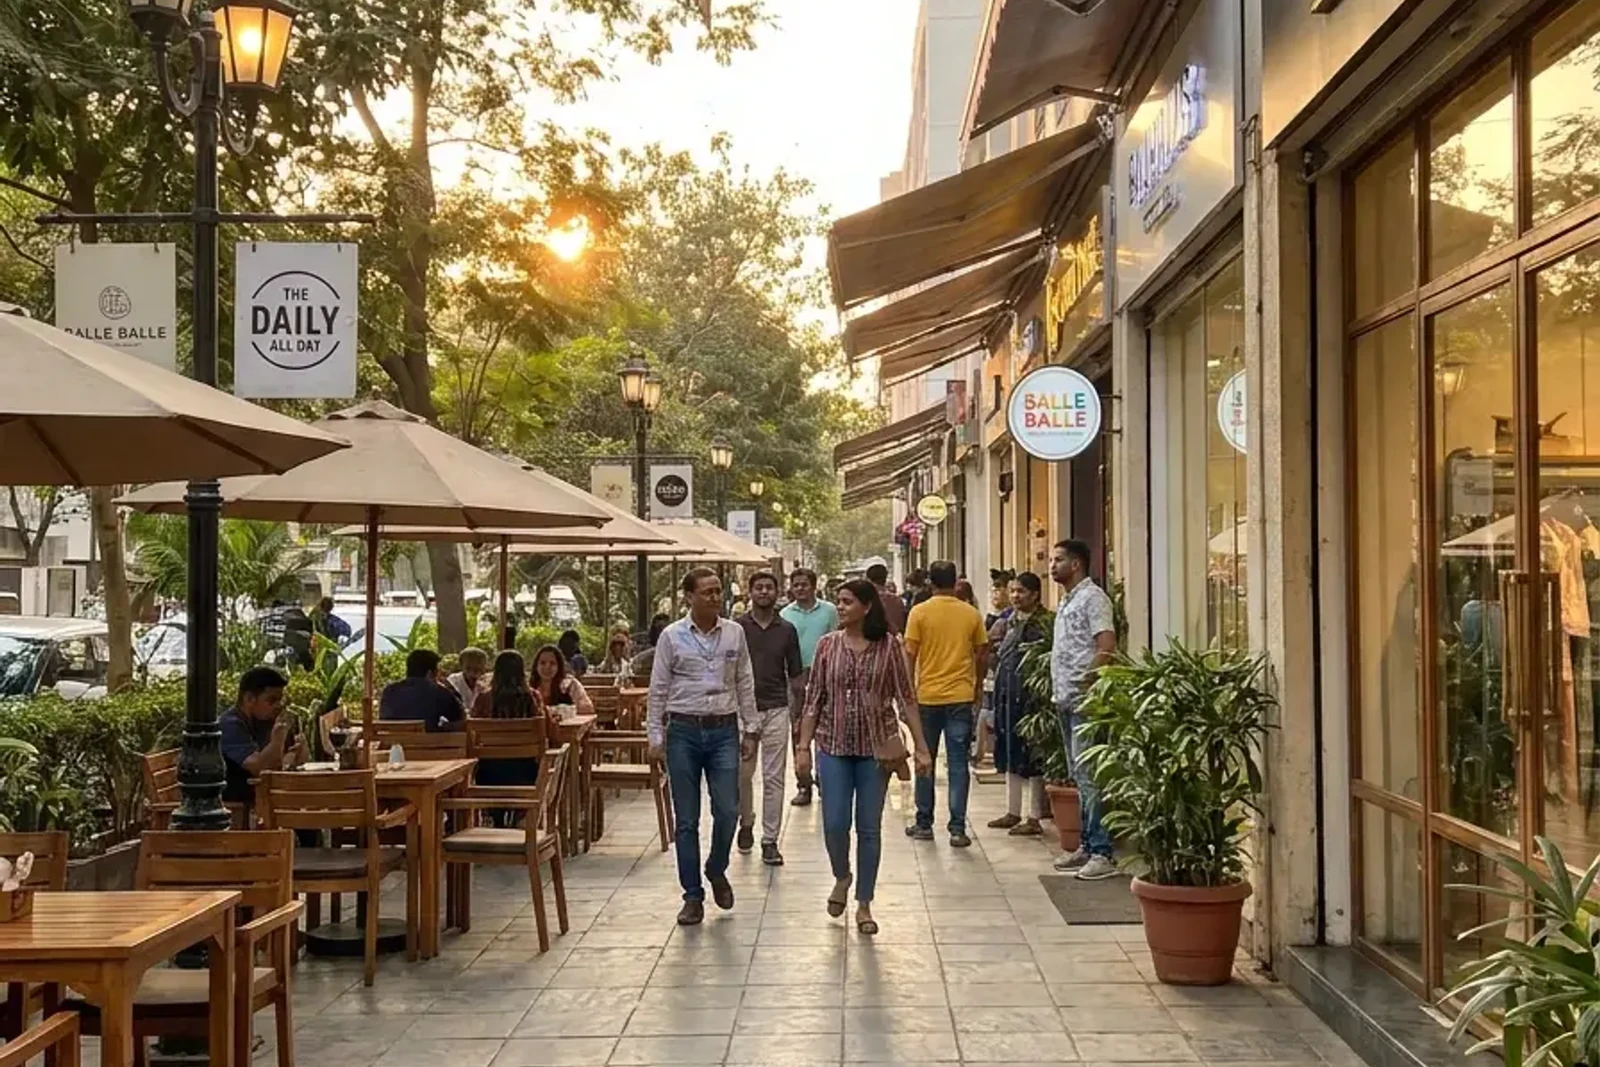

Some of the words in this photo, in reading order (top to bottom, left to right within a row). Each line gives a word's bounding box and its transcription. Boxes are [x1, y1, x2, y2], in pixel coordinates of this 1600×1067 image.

[283, 287, 309, 301] THE
[251, 305, 340, 335] DAILY
[117, 326, 167, 339] BALLE
[269, 339, 293, 352] ALL
[1024, 393, 1086, 410] BALLE
[1024, 411, 1087, 428] BALLE
